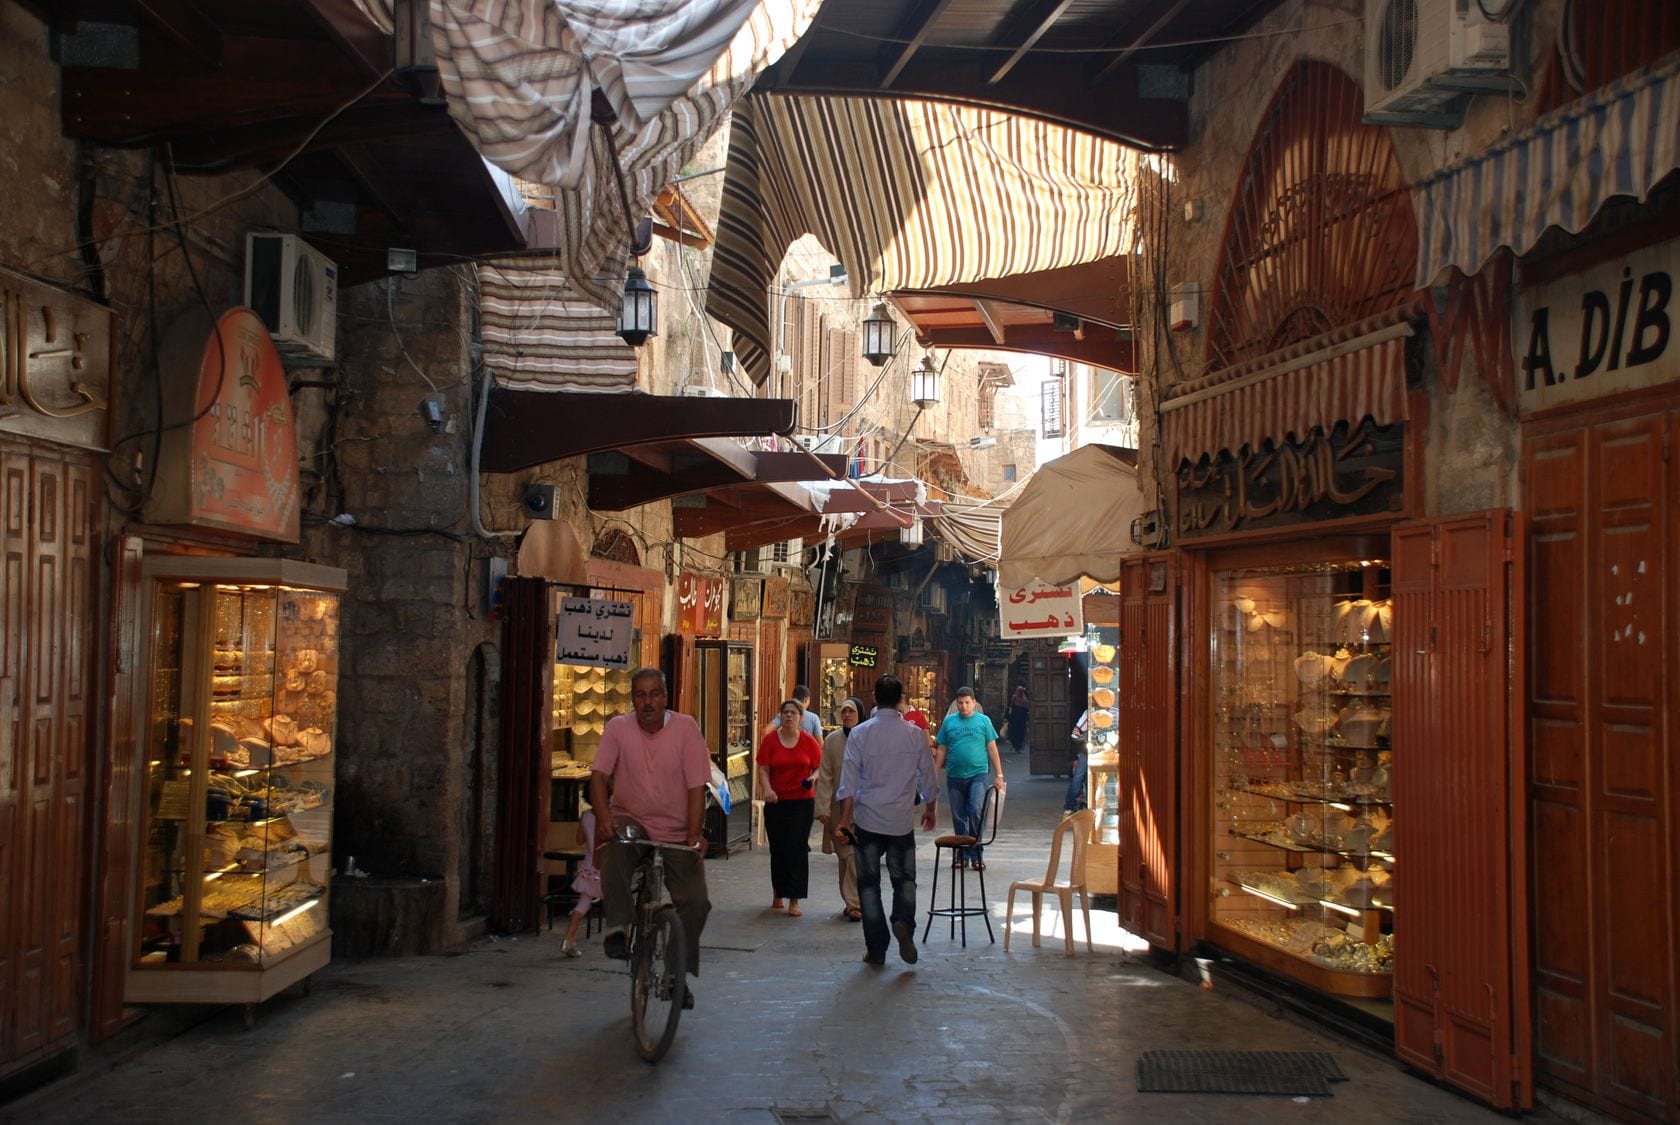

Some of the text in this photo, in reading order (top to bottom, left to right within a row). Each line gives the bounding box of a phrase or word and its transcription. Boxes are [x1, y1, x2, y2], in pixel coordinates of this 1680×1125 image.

[564, 600, 632, 620] نشتري ذهب
[1008, 611, 1075, 635] ذهب
[577, 624, 614, 644] لدينا
[557, 647, 629, 666] ذهب مستعمل
